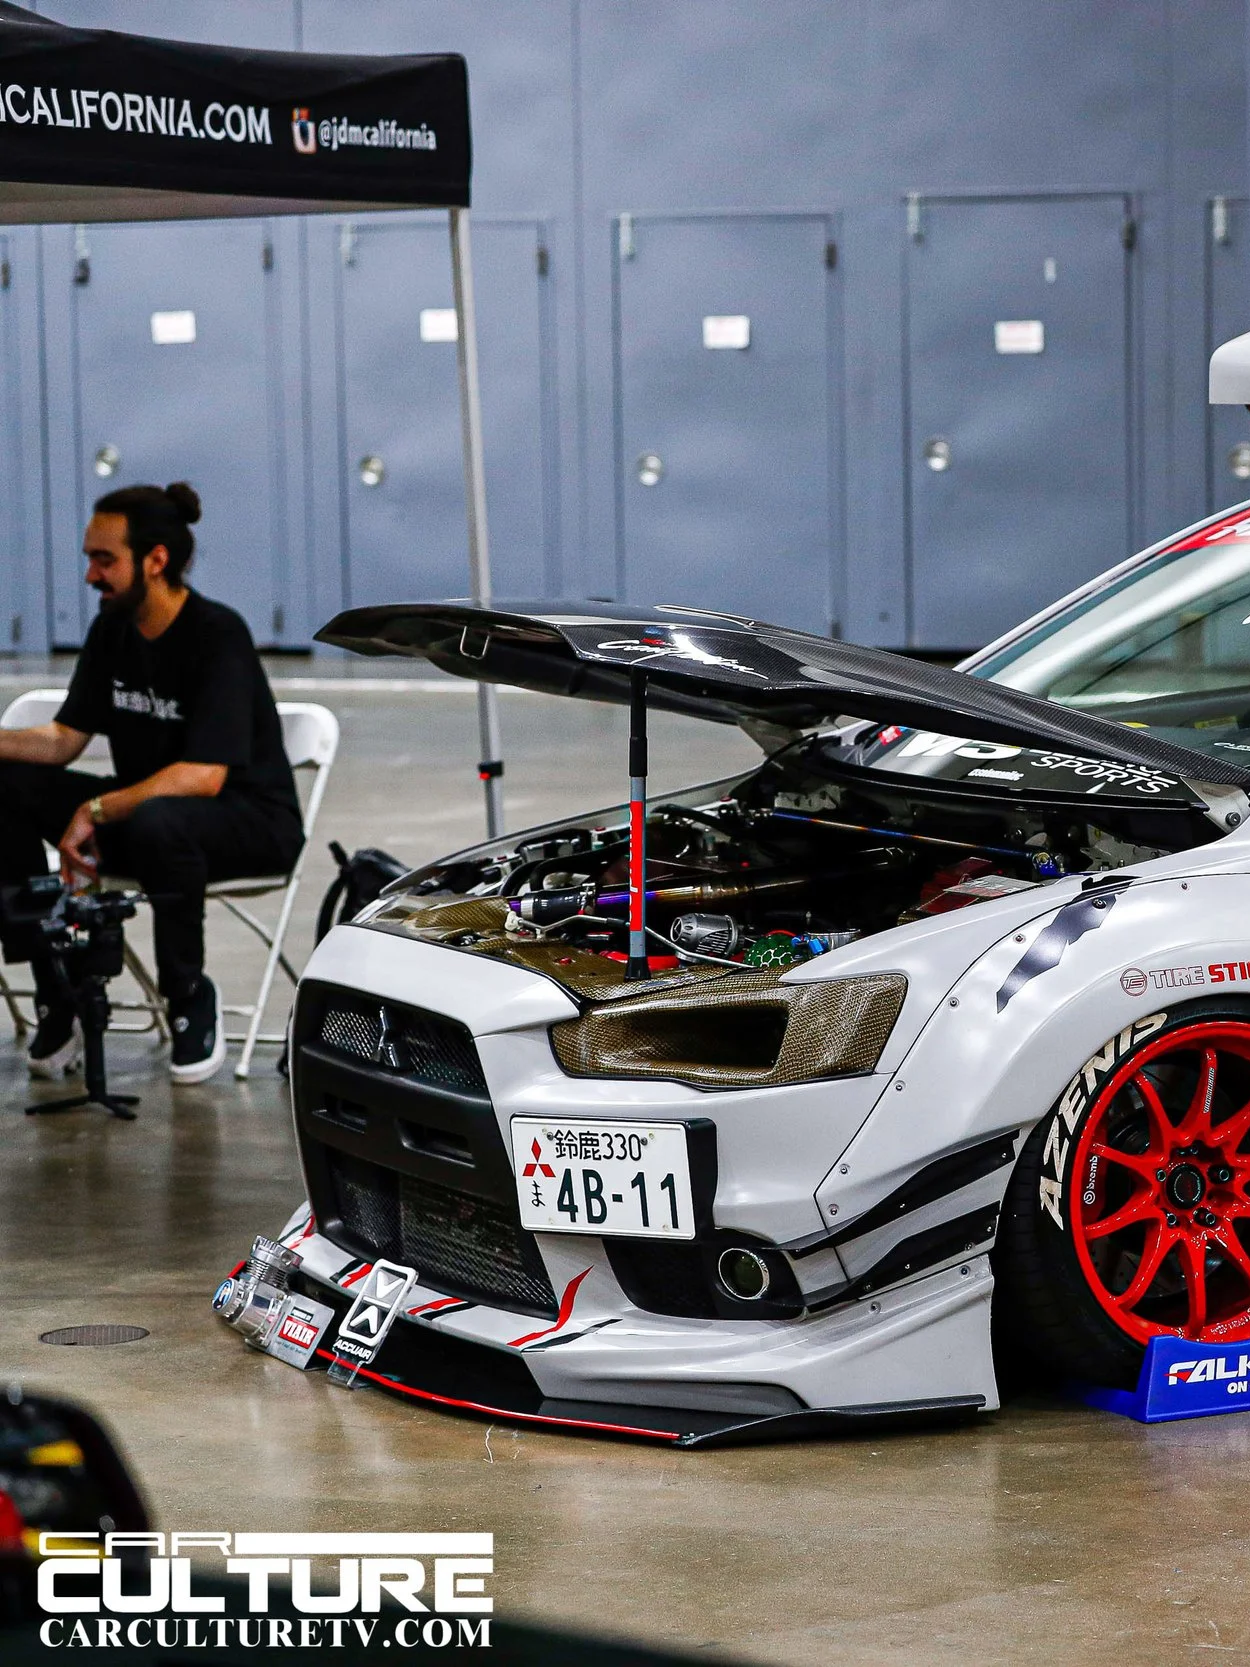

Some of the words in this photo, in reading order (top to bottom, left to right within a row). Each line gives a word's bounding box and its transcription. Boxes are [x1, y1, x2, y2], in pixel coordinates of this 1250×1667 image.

[318, 117, 437, 152] @jdmcalifornia
[1031, 756, 1169, 793] SPORTS
[1149, 966, 1204, 988] TIRE
[553, 1129, 642, 1161] 鈴鹿330
[1086, 1155, 1098, 1190] bremb
[531, 1180, 546, 1208] ま
[557, 1168, 680, 1229] 4B-11
[282, 1319, 316, 1345] VIAIR
[333, 1339, 373, 1360] ACCUAIR
[1227, 1382, 1247, 1394] ON
